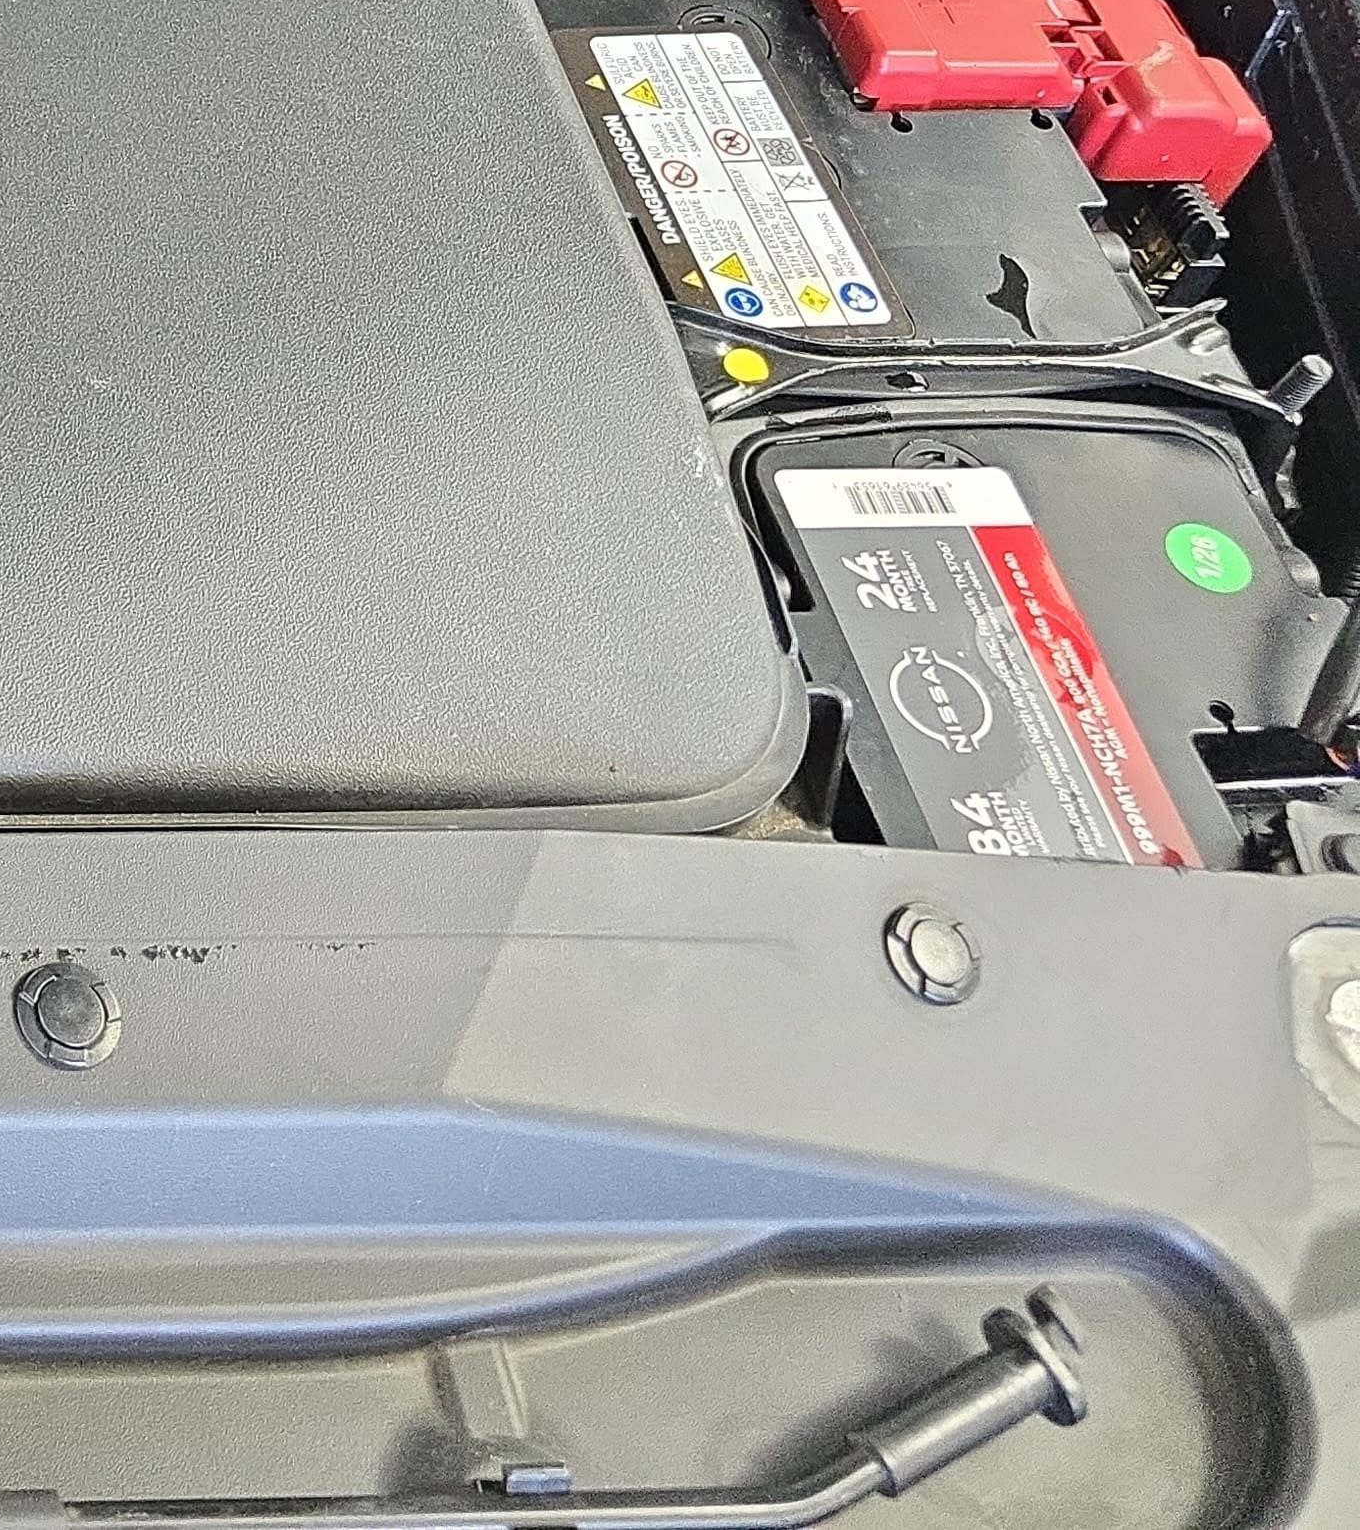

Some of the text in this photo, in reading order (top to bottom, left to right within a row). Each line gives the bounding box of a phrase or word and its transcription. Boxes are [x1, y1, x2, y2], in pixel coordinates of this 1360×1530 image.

[595, 42, 625, 83] SULFURIC
[615, 57, 634, 77] ACID
[627, 55, 643, 71] CAN
[632, 41, 674, 108] CAUSE BLINDNESS
[706, 46, 730, 74] DO NOT
[723, 53, 743, 74] OPEN
[659, 68, 681, 96] SEVERE
[675, 56, 720, 124] KEEP OUT OF THE
[703, 85, 717, 94] OF
[674, 97, 687, 108] OR
[709, 97, 732, 124] REACH
[734, 95, 761, 131] BATTERY
[746, 96, 773, 131] MUST BE
[651, 123, 674, 152] SPARKS
[664, 121, 688, 151] FLAMES
[674, 115, 701, 151] SMOKING
[647, 145, 663, 158] NO
[600, 114, 682, 243] DANGER/POISON
[687, 198, 724, 251] EXPLOSIVE
[728, 168, 795, 279] FLUSH EYES IMMEDIATELY
[758, 202, 776, 218] GET
[673, 197, 714, 260] SHIELD EYES.
[711, 218, 738, 250] GASES
[765, 189, 820, 277] MEDICAL HELP FAST.
[816, 211, 859, 275] INSTRUCTIONS.
[726, 219, 784, 316] CAN CAUSE BLINDNESS
[786, 255, 807, 278] WITH
[825, 253, 846, 276] READ
[782, 303, 796, 315] OR
[935, 540, 961, 572] 37067
[1000, 552, 1021, 569] Ah
[838, 551, 900, 608] 24
[874, 549, 918, 611] MONTH
[900, 569, 918, 590] FREE
[900, 549, 939, 611] REPLACEMENT
[952, 574, 969, 589] TN
[960, 559, 982, 589] details.
[959, 591, 993, 635] Franklin,
[976, 591, 1004, 631] warranty
[996, 633, 1025, 674] complete
[1048, 651, 1074, 677] CCA
[1016, 676, 1030, 689] for
[1056, 637, 1108, 716] Nonspillable
[908, 645, 974, 753] NISSAN
[1023, 690, 1056, 738] dealership
[1016, 709, 1043, 742] North
[1047, 741, 1070, 771] Nissan
[1102, 727, 1129, 757] AGM
[1033, 745, 1063, 783] Nissan
[1052, 786, 1072, 801] by
[1063, 773, 1083, 794] your
[1072, 708, 1161, 854] 999M1-NCH7A
[946, 791, 1013, 855] 84
[1010, 807, 1036, 845] LIMITED
[1016, 798, 1050, 853] WARRANTY
[1082, 815, 1106, 846] Please
